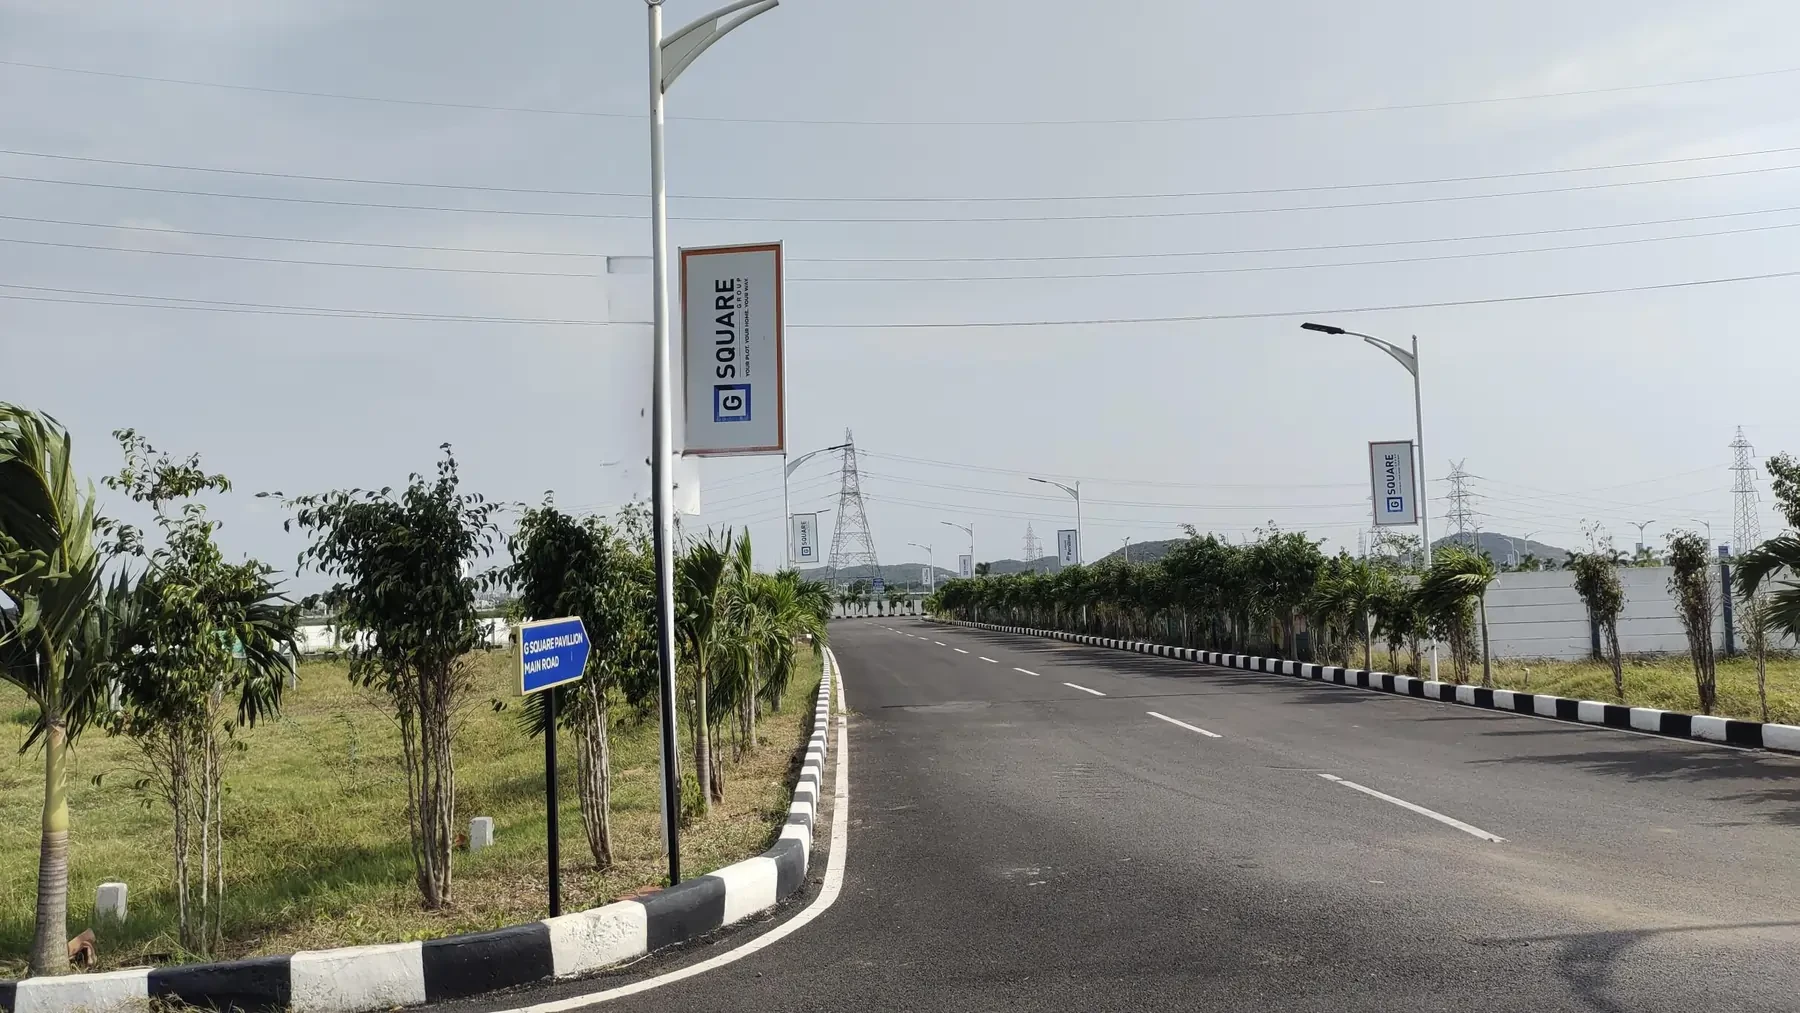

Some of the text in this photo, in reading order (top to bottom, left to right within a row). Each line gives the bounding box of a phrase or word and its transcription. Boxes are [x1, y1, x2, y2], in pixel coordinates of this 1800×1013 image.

[715, 278, 742, 411] G SQUARE
[1385, 454, 1396, 495] SQUARE
[524, 633, 583, 655] G SQUARE PAVILLION
[524, 656, 559, 675] MAIN ROAD
